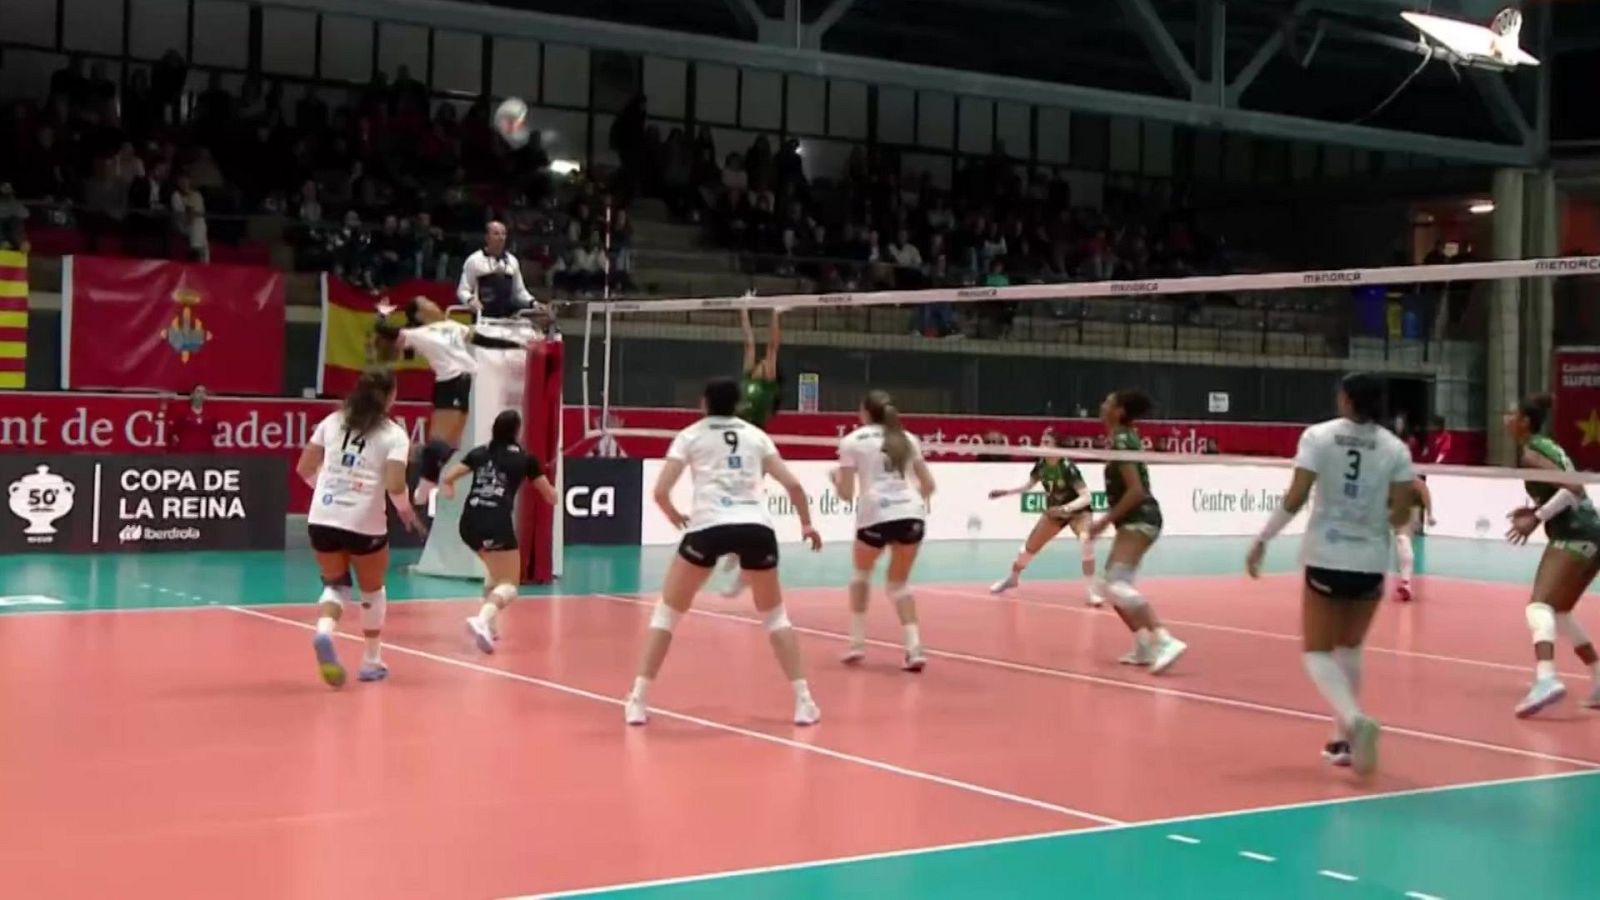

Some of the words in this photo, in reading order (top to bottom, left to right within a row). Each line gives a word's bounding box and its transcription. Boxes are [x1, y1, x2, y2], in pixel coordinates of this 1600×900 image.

[1535, 259, 1600, 270] MENORC
[61, 407, 114, 446] de
[342, 427, 366, 454] 14
[723, 429, 738, 454] 9
[1343, 449, 1361, 480] 3
[120, 469, 197, 491] COPA
[203, 469, 240, 491] DE
[119, 497, 155, 519] LA
[162, 496, 246, 519] REINA
[1192, 488, 1237, 512] Centre
[1239, 488, 1256, 513] de
